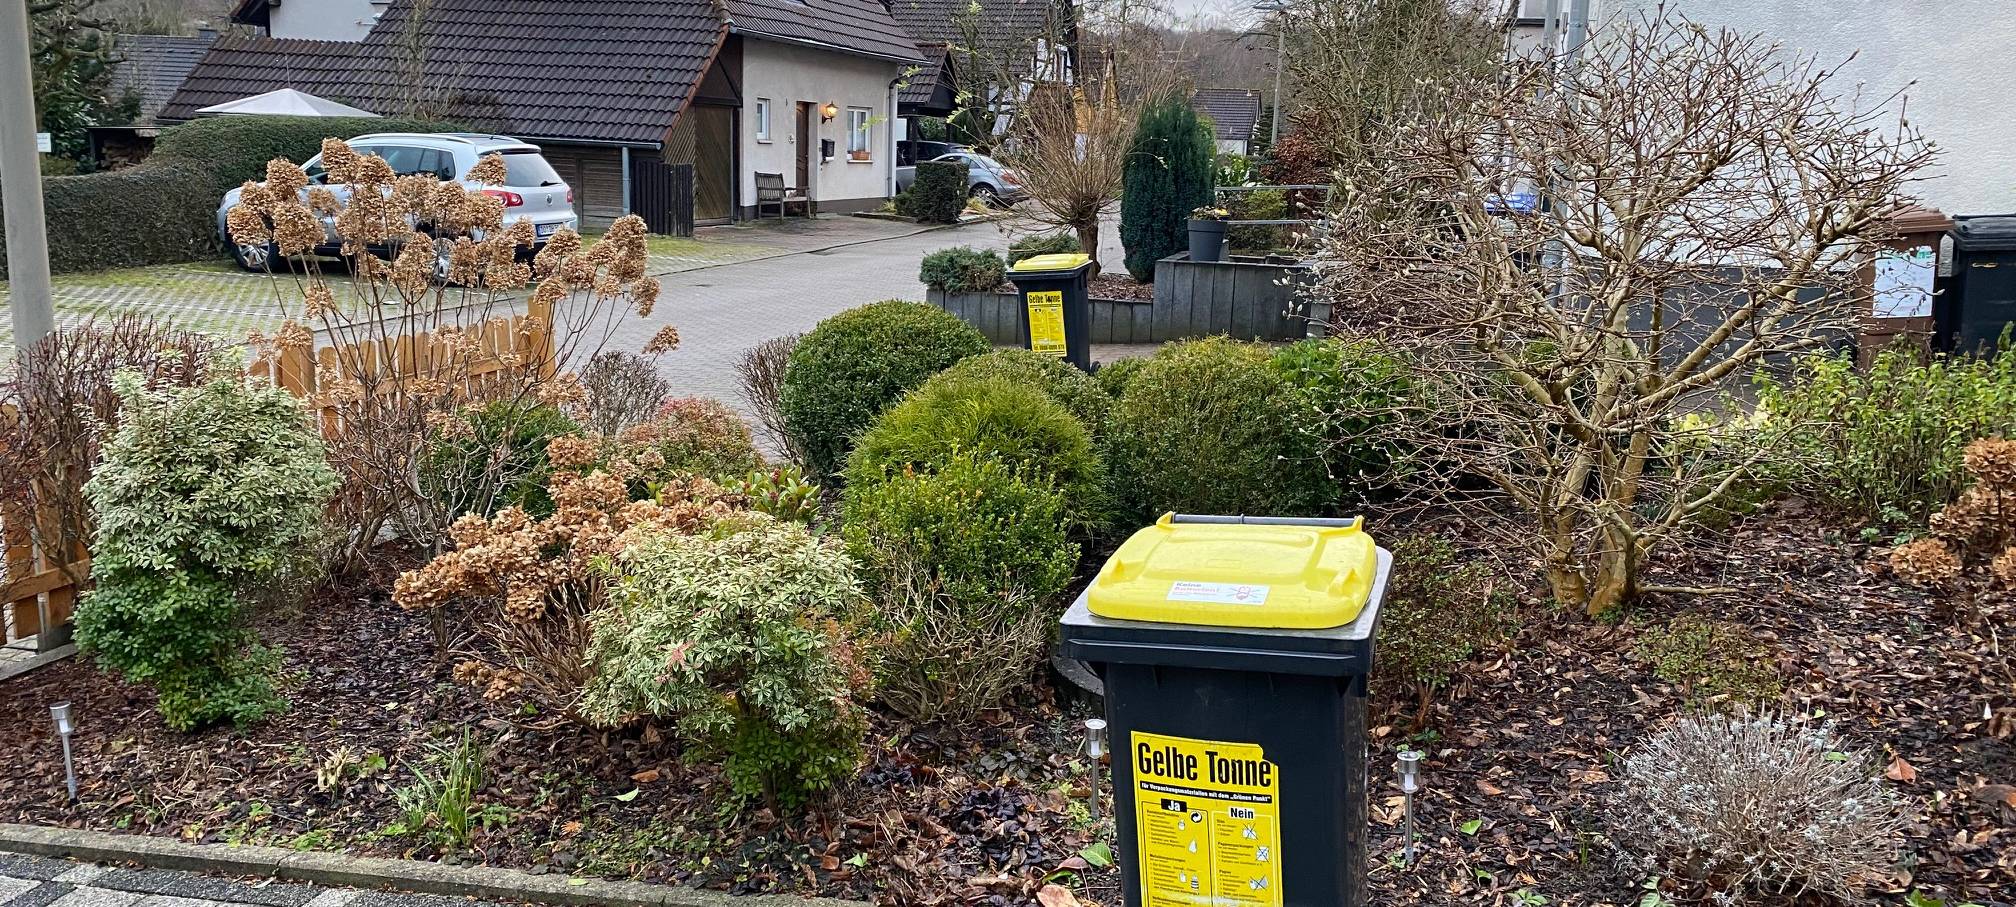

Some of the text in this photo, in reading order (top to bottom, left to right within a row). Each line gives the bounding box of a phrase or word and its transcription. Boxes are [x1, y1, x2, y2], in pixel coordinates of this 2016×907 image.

[1137, 742, 1271, 787] Gelbe Tonne
[1168, 800, 1181, 811] Ja
[1230, 807, 1254, 819] Nein
